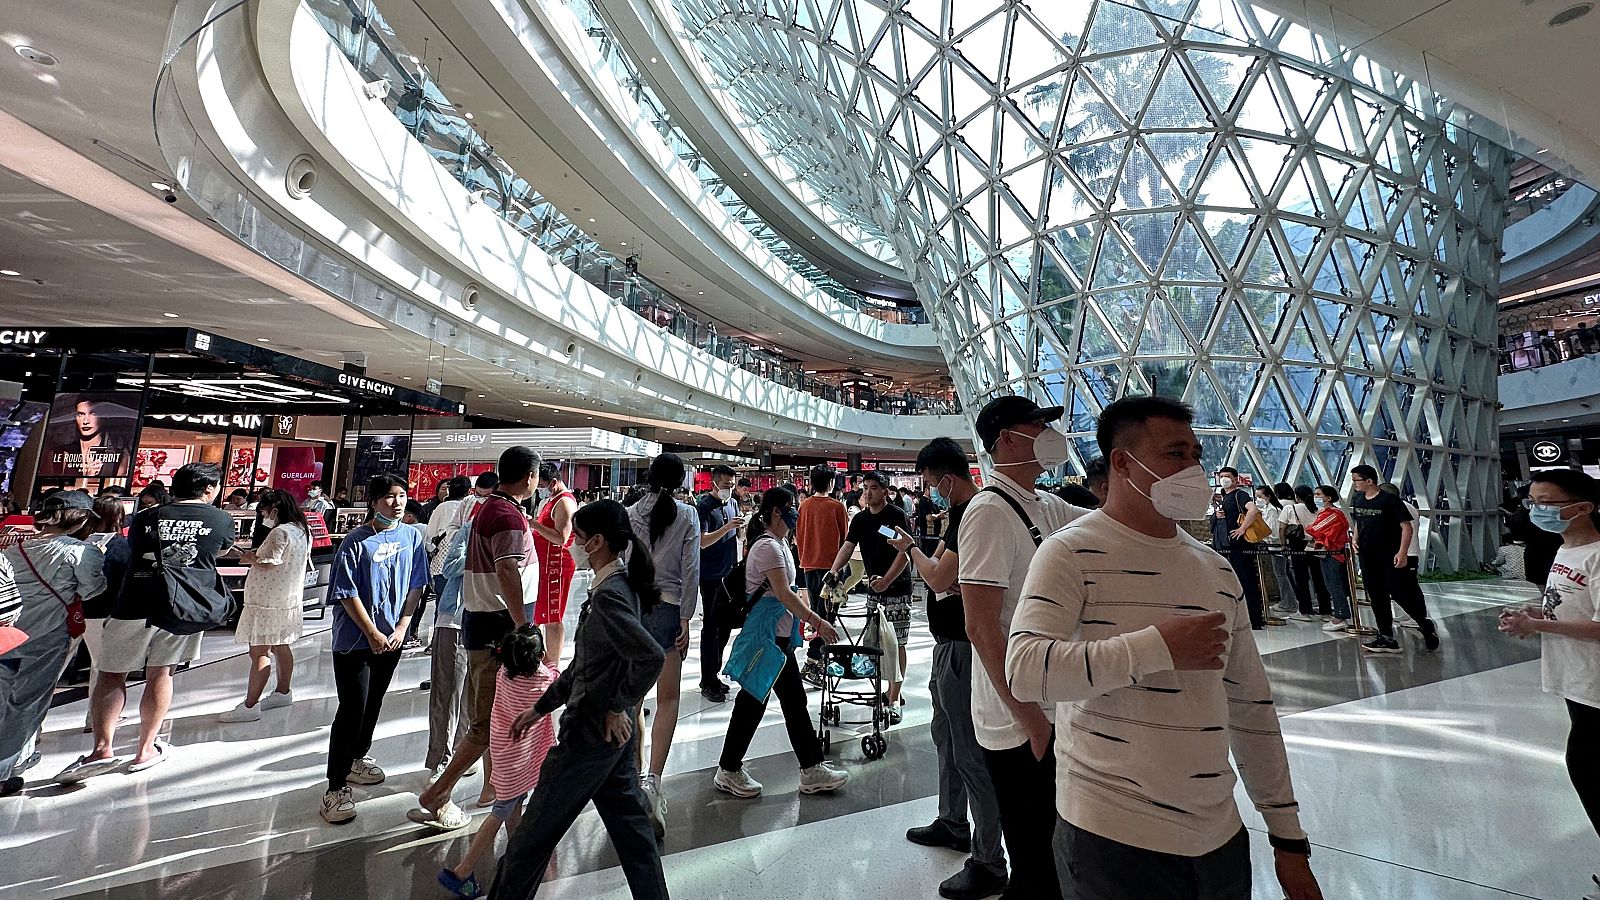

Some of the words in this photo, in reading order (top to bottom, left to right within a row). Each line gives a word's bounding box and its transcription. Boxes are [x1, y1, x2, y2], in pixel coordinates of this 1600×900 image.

[0, 330, 47, 344] CHY
[338, 373, 395, 396] GIVENCHY
[445, 432, 487, 443] sisley
[53, 453, 63, 463] LE
[175, 519, 204, 528] OVER
[172, 526, 198, 535] FEAR
[198, 528, 213, 536] OF
[160, 533, 198, 542] EIGHTS.
